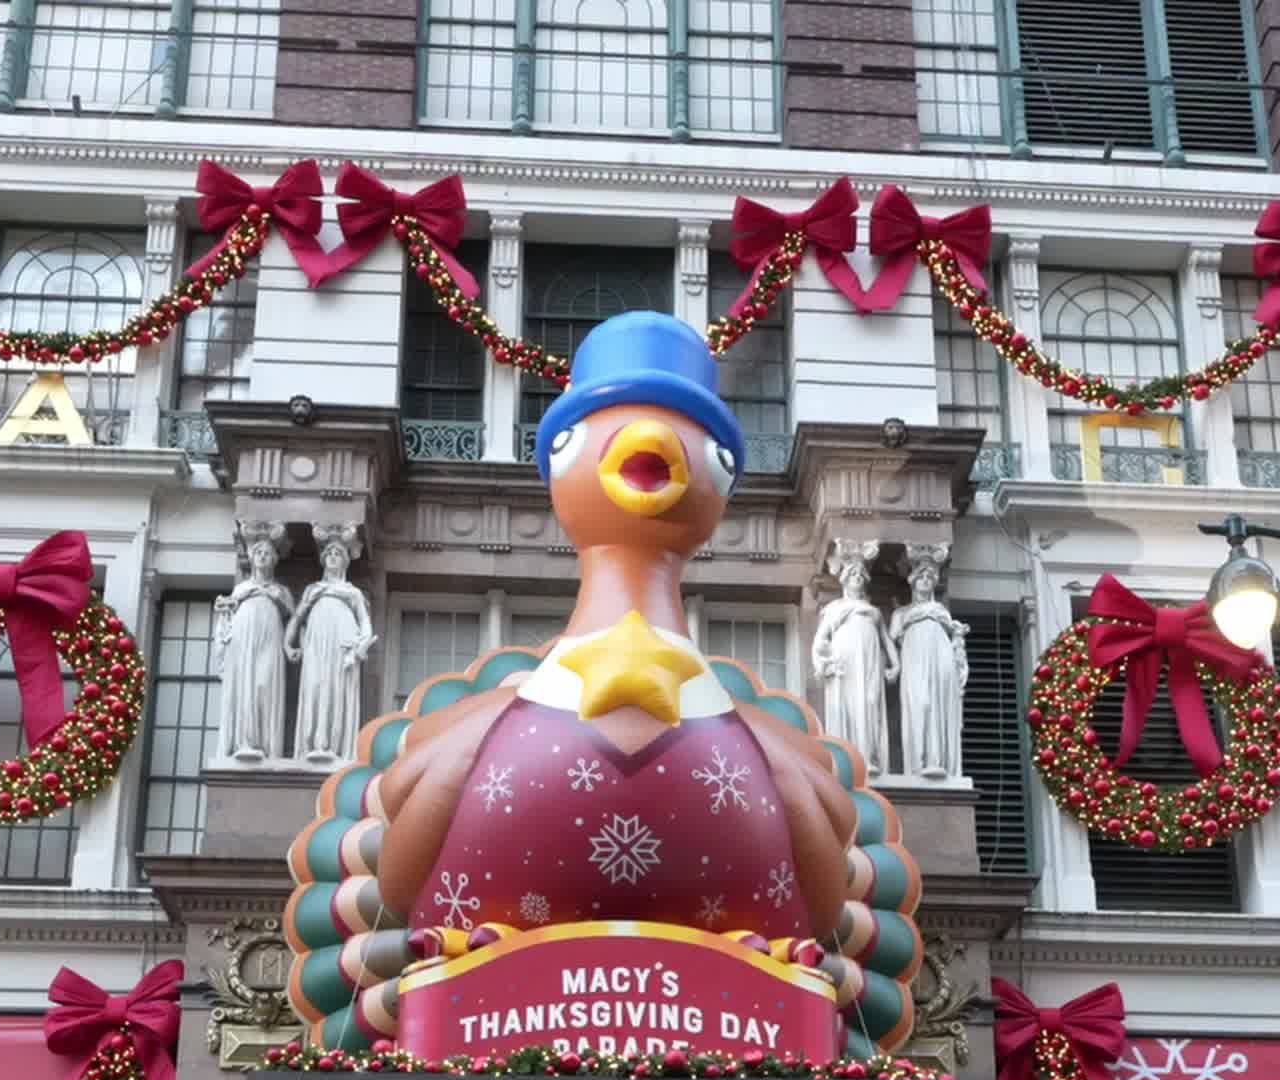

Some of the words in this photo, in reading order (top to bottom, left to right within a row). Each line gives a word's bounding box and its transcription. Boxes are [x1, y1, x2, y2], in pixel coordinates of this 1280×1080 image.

[562, 961, 680, 997] MACY'S
[459, 1001, 704, 1043] THANKSGIVING
[720, 1012, 781, 1049] DAY
